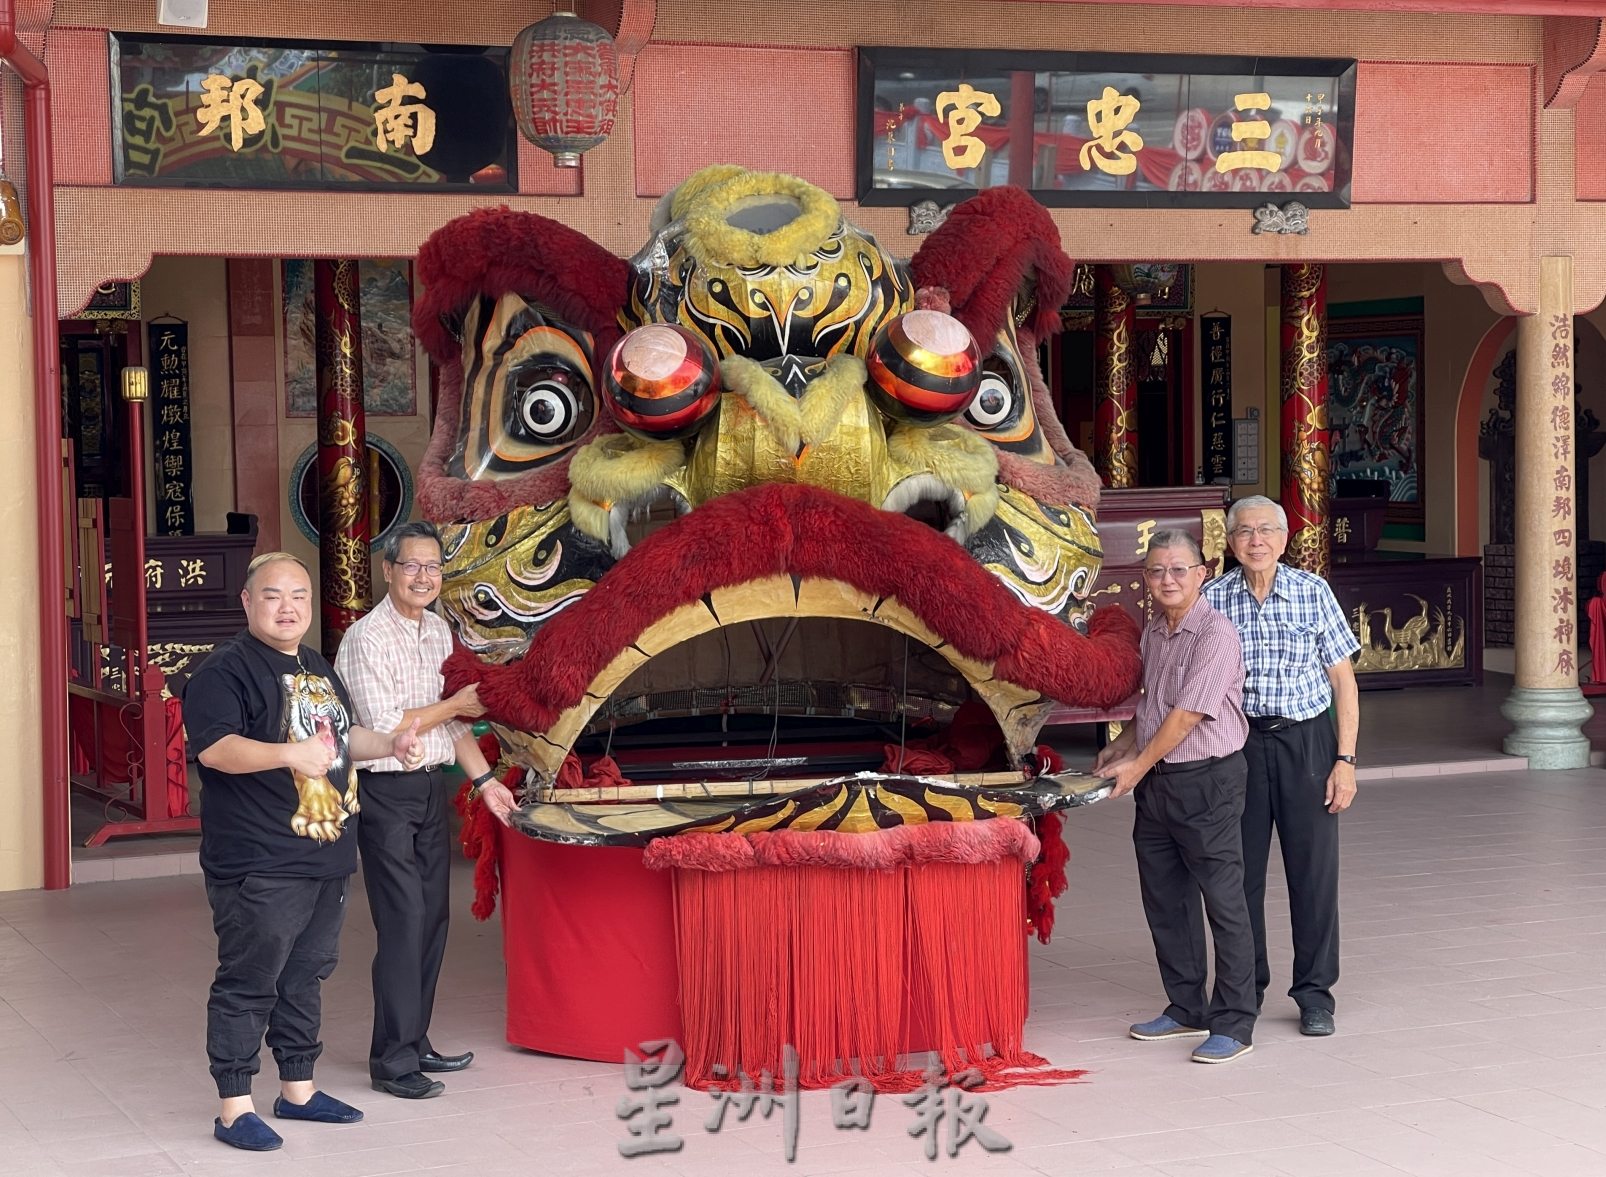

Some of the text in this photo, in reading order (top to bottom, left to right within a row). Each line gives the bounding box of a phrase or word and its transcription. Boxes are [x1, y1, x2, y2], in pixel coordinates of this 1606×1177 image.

[197, 74, 436, 155] 南邦
[936, 84, 1282, 175] 三忠宮
